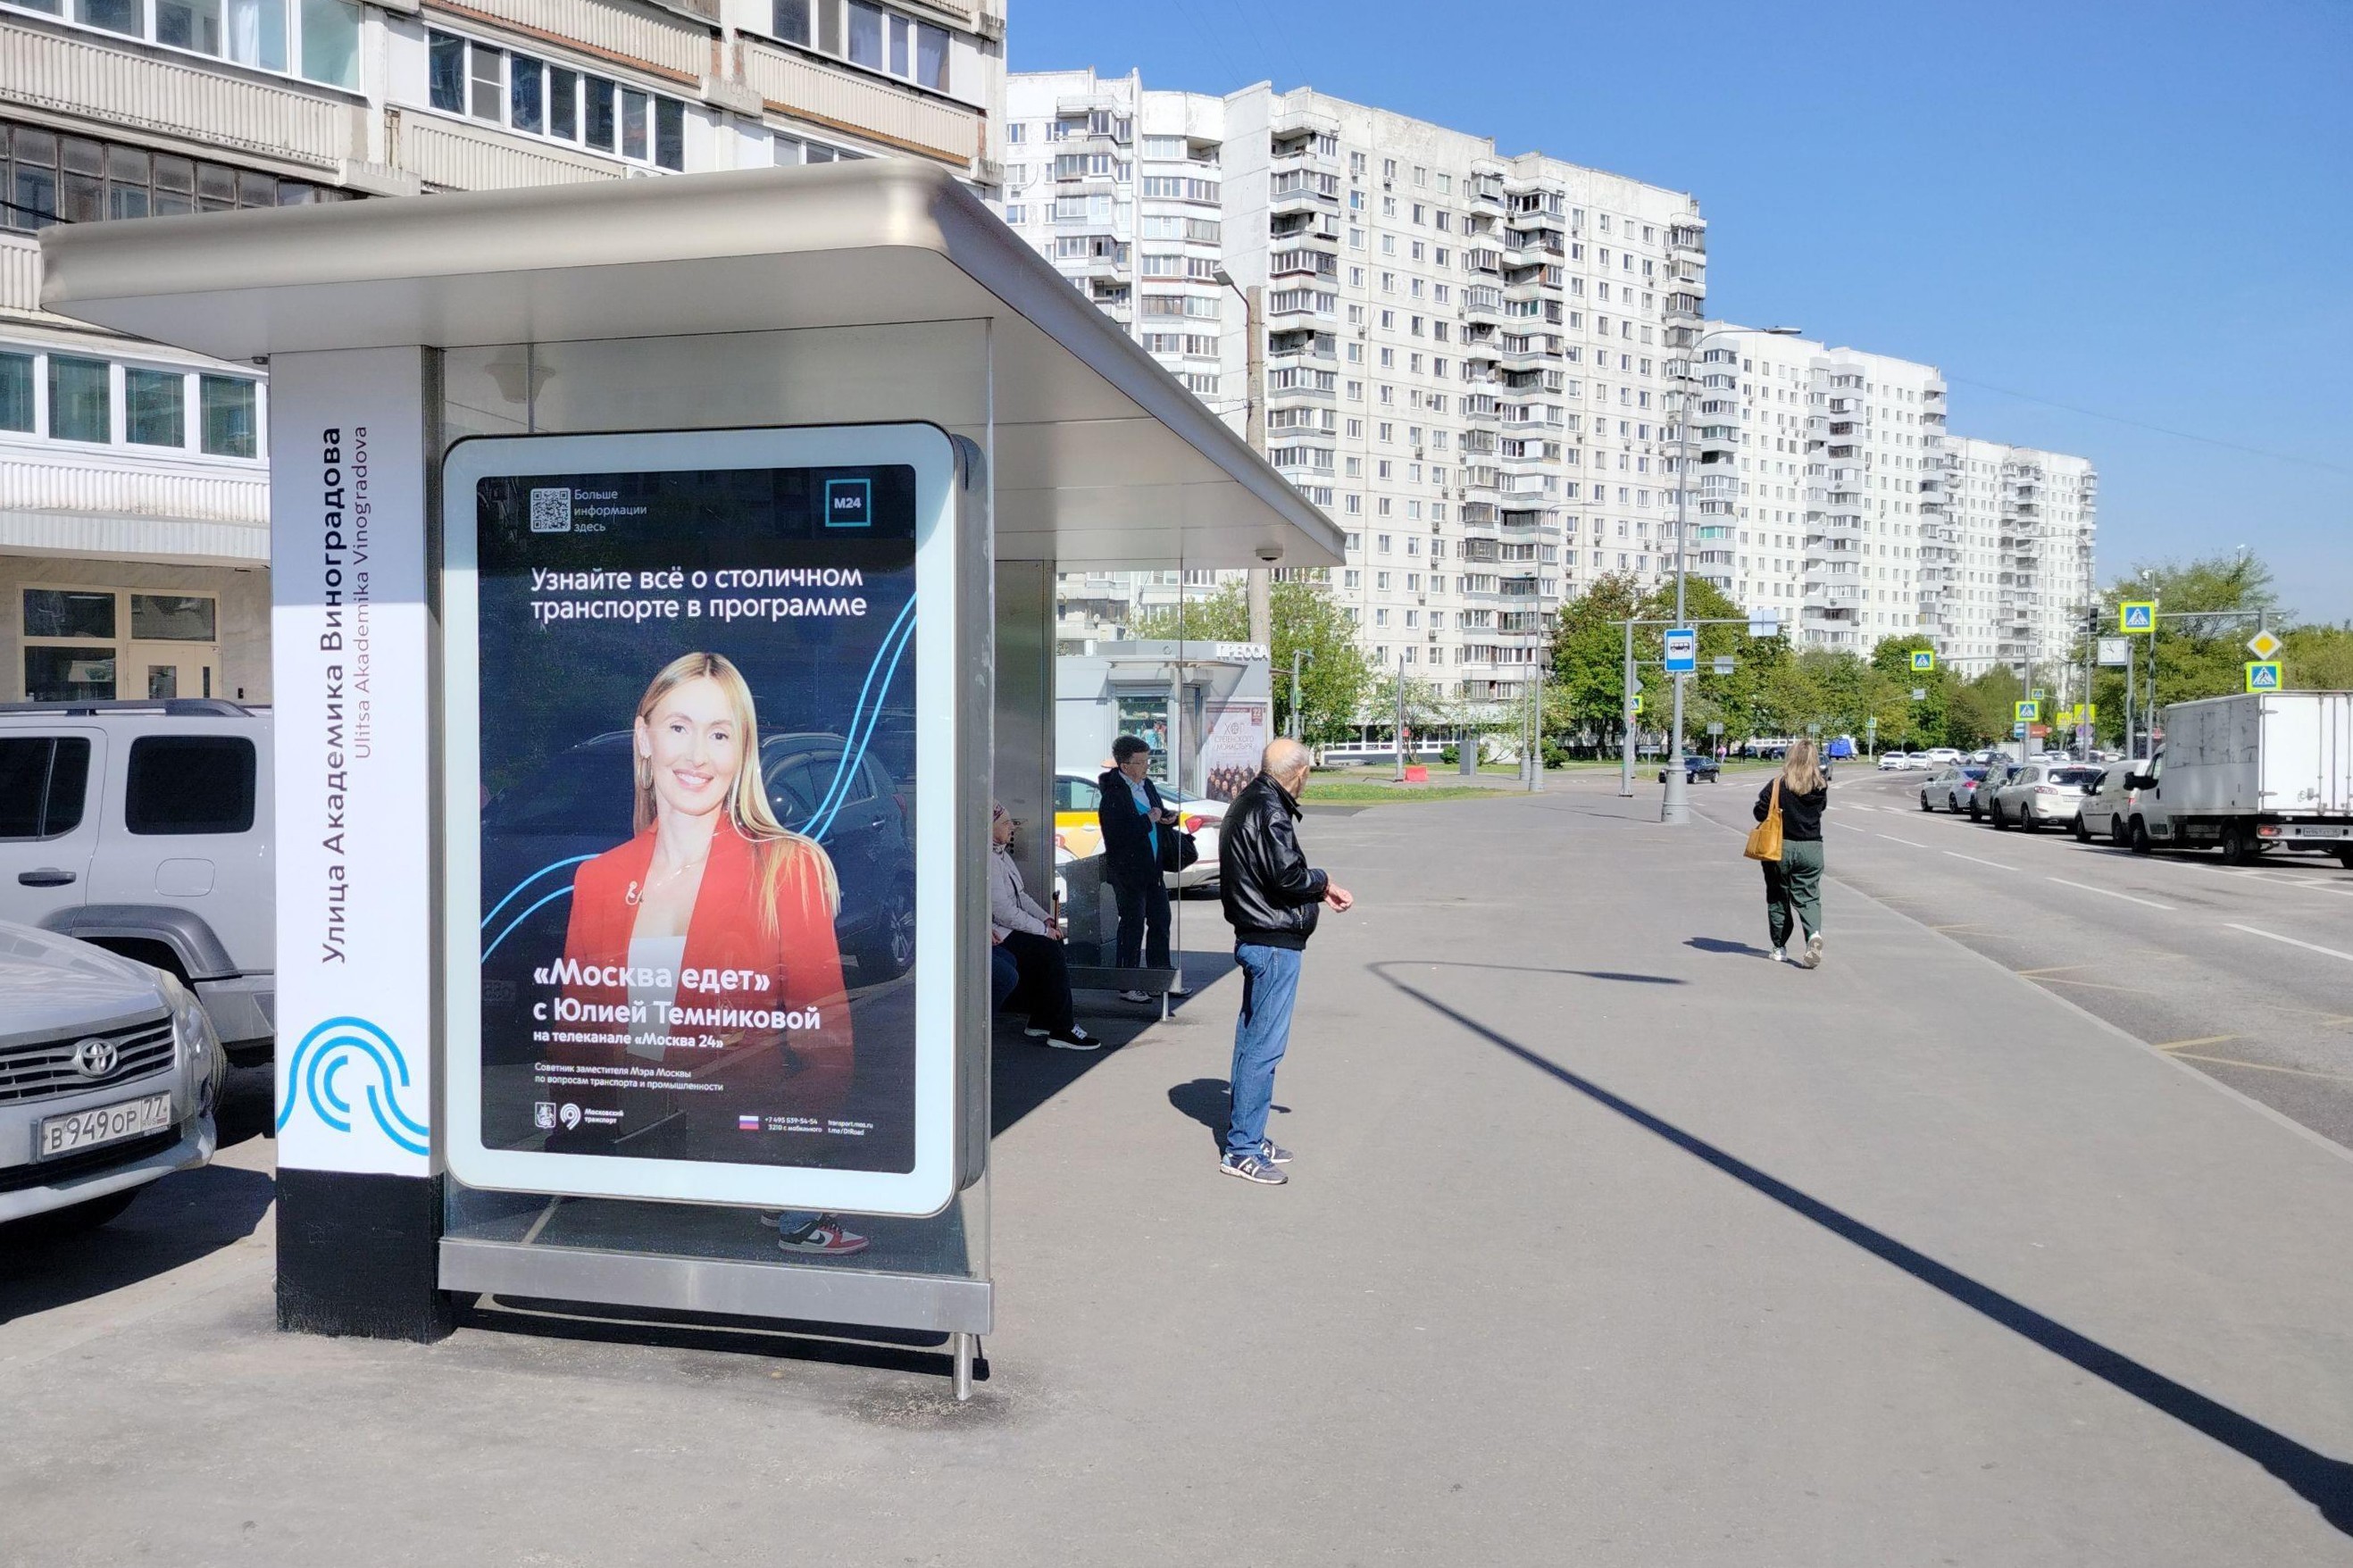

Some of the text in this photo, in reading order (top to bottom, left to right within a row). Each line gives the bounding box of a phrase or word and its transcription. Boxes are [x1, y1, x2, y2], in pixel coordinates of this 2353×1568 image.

[574, 488, 619, 500] Больше
[574, 504, 648, 519] информации
[573, 521, 606, 535] здесь
[530, 565, 863, 592] Узнайте всё о столичном
[351, 426, 371, 759] Ulitsa Akademika Vinogradova
[531, 597, 868, 624] транспорте в программе
[1216, 643, 1268, 659] ПРЕССА
[320, 428, 348, 963] Улица Академика Виноградова
[1253, 708, 1262, 717] 22
[533, 958, 771, 994] «Москва едет»
[533, 997, 821, 1030] с Юлией Темниковой
[533, 1030, 724, 1049] на телеканале «Москва 24»
[535, 1063, 691, 1079] Советник заместителя Мэра Москвы
[535, 1075, 546, 1084] по
[547, 1076, 589, 1087] вопросам
[590, 1079, 638, 1089] транспорта
[647, 1081, 724, 1092] промышленности
[584, 1107, 624, 1117] Московский
[773, 1116, 786, 1124] 495
[584, 1116, 617, 1125] транспорт
